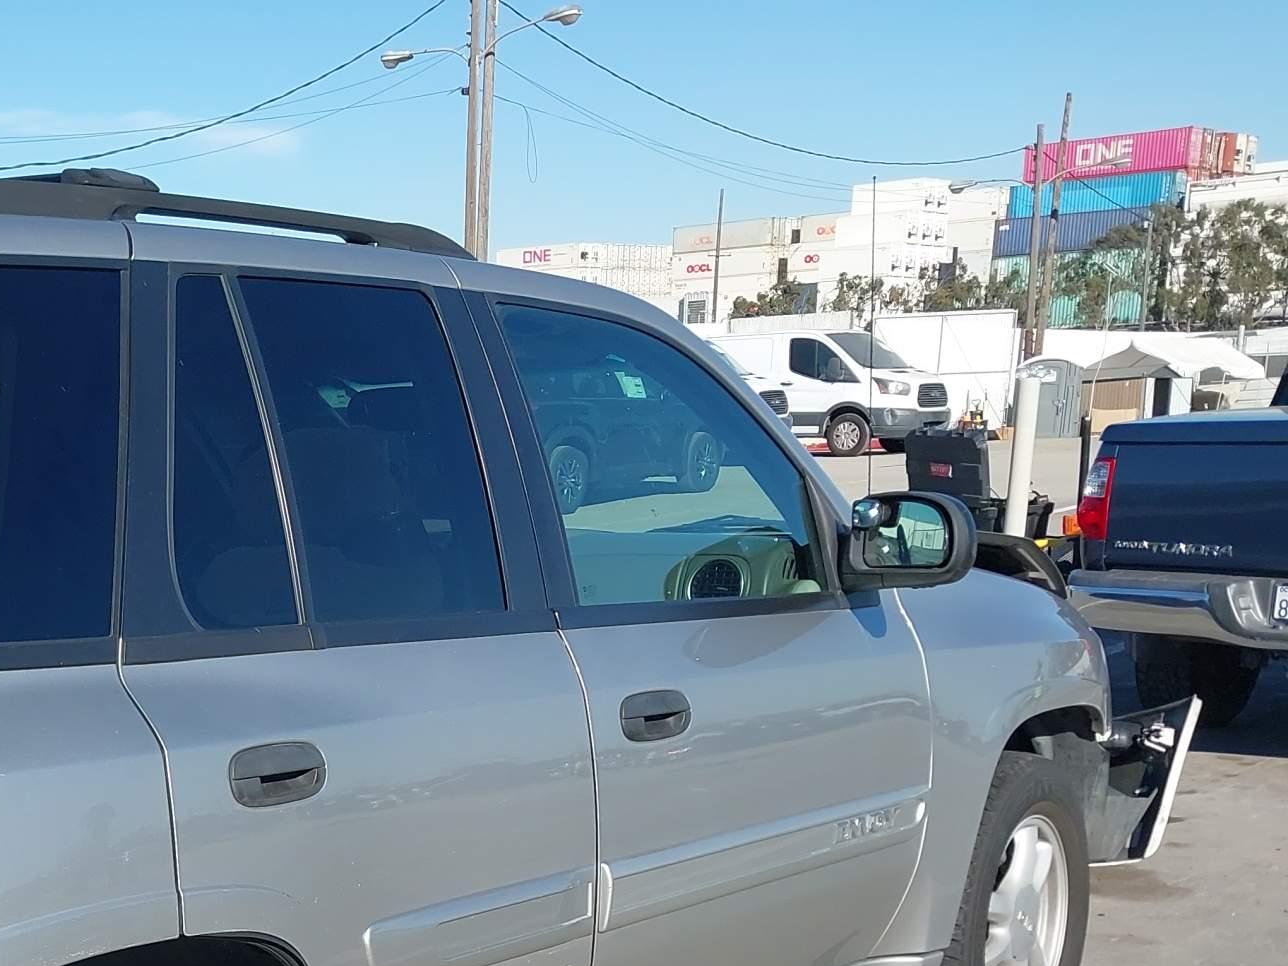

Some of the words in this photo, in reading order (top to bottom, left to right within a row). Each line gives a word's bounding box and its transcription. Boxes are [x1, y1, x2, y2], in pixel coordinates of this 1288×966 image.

[1075, 139, 1133, 166] ONE
[523, 249, 552, 264] ONE
[686, 264, 712, 274] OOCL
[1151, 542, 1233, 557] TUNDRA
[834, 807, 902, 845] ENVOY
